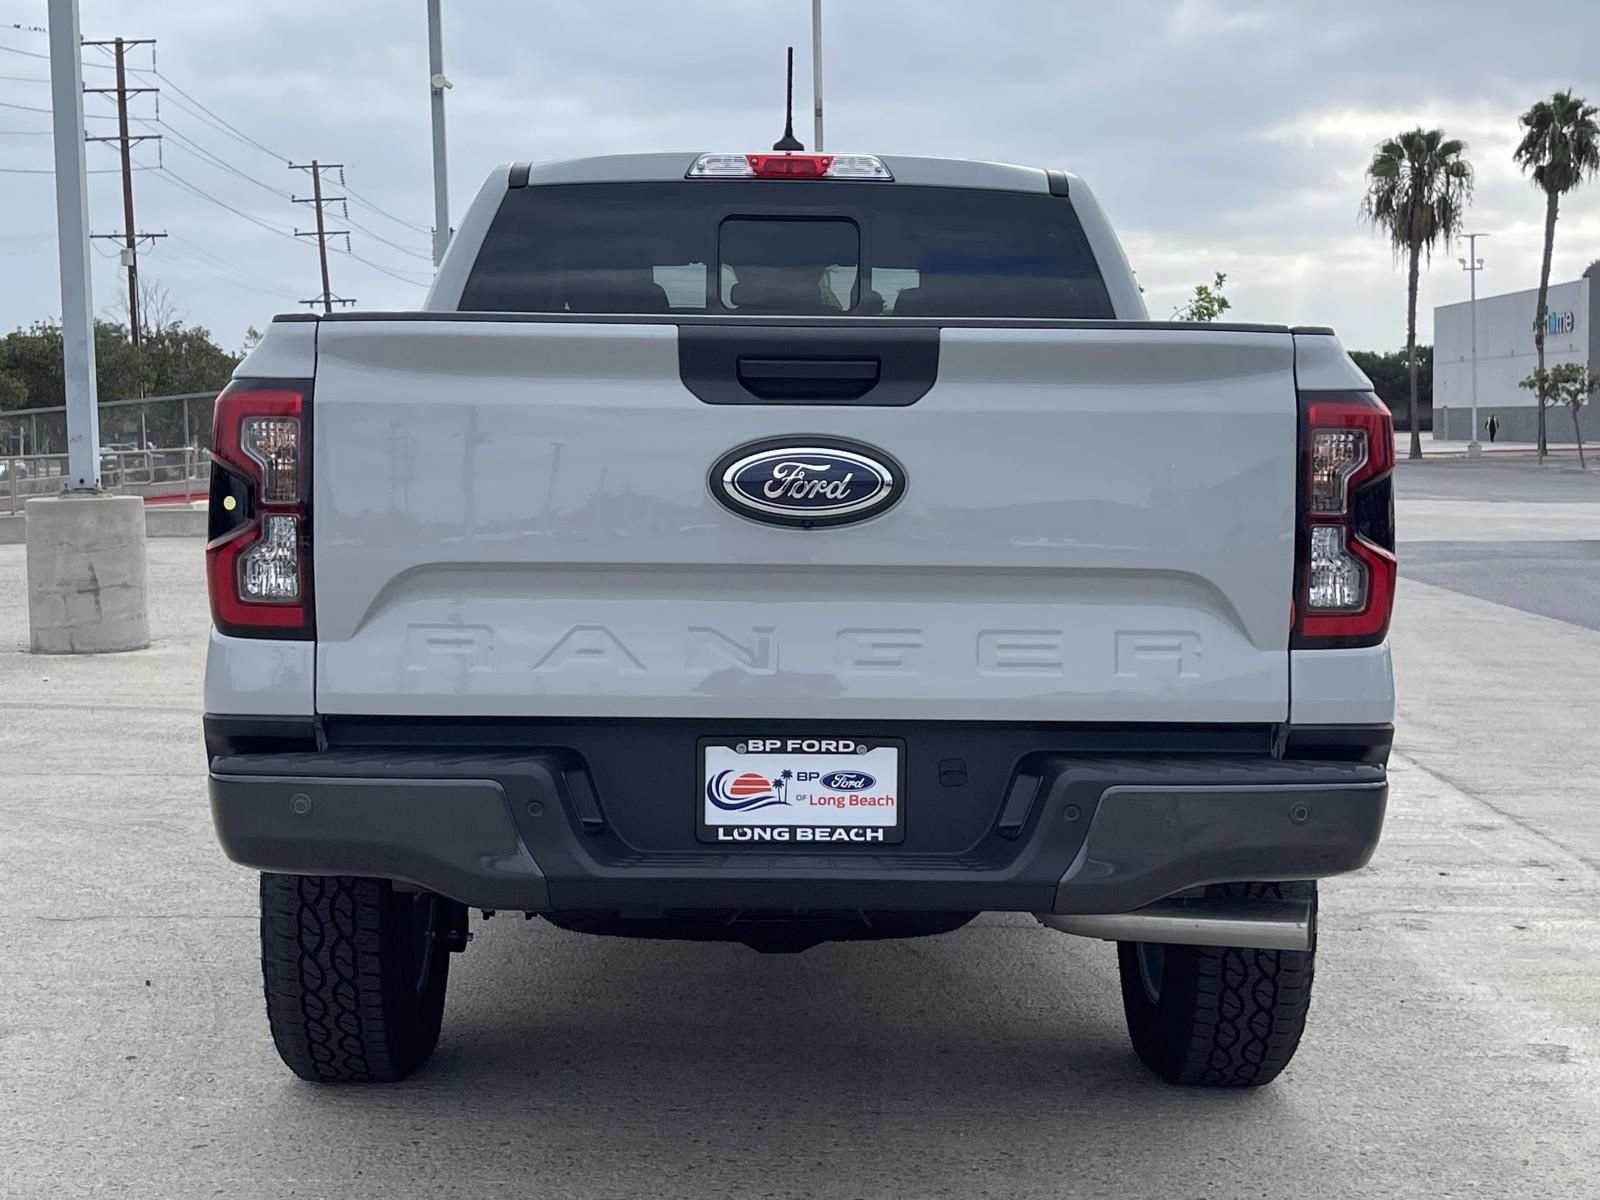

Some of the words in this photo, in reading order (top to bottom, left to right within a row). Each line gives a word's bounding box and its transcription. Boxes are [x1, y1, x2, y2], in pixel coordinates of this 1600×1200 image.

[763, 461, 853, 499] Ford
[404, 625, 1201, 676] RANGER
[747, 740, 781, 752] BP
[787, 740, 855, 752] FORD
[796, 772, 820, 782] BP
[831, 773, 864, 789] Ford
[809, 794, 845, 808] Long
[849, 794, 894, 807] Beach
[718, 827, 790, 841] LONG
[796, 827, 884, 841] BEACH
